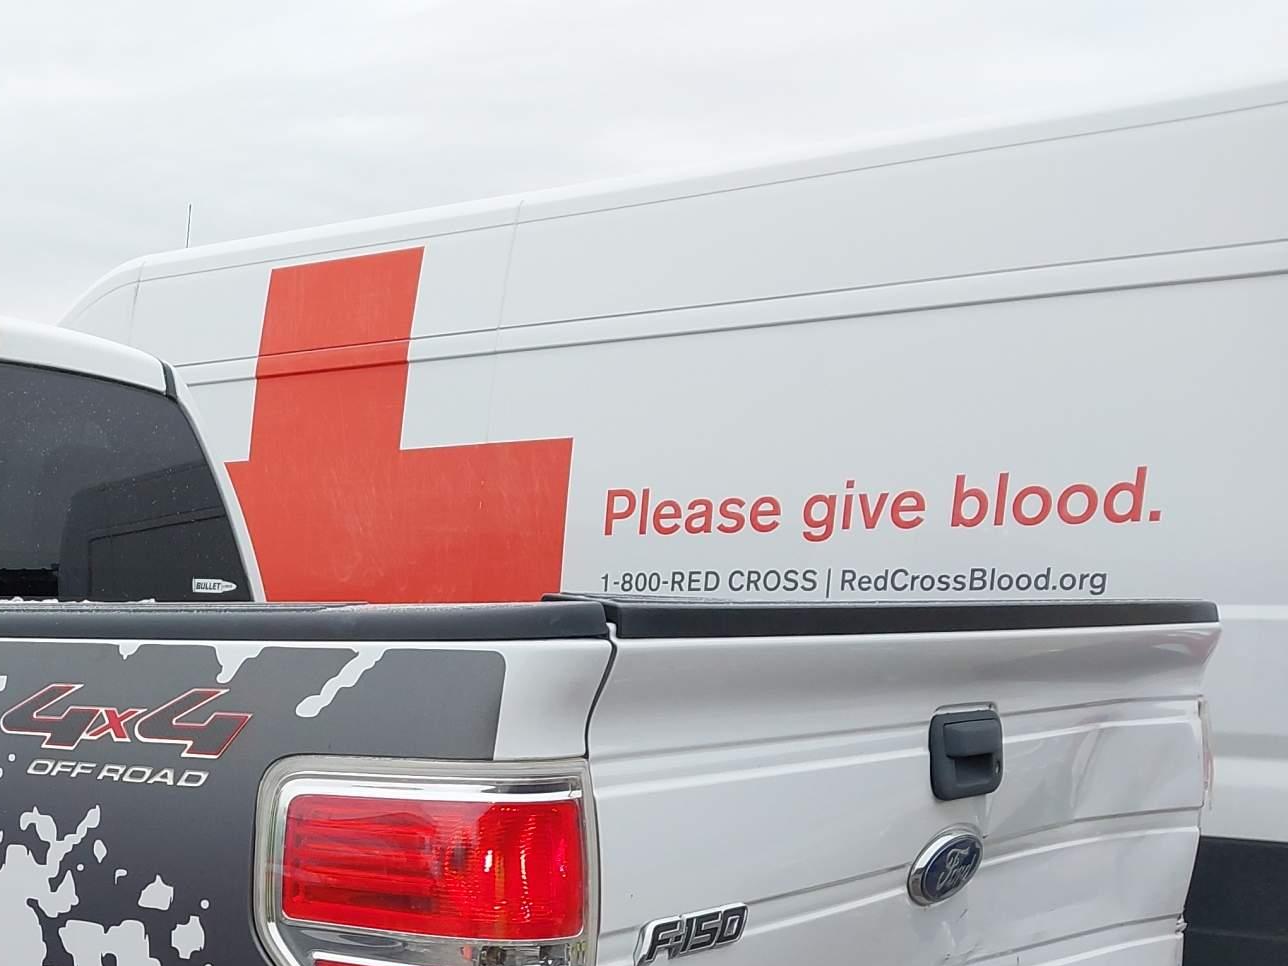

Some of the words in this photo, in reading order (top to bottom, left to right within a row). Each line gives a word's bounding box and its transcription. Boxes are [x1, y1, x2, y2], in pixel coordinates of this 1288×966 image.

[603, 488, 781, 537] Please
[802, 479, 926, 543] give
[951, 467, 1162, 529] blood.
[195, 581, 223, 591] BULLET
[601, 570, 720, 592] 1-800-RED
[728, 569, 818, 592] CROSS
[840, 567, 1108, 597] RedCrossBlood.org
[0, 682, 254, 760] 4x4
[26, 758, 97, 778] OFF
[97, 763, 210, 788] ROAD
[636, 902, 750, 965] F-150
